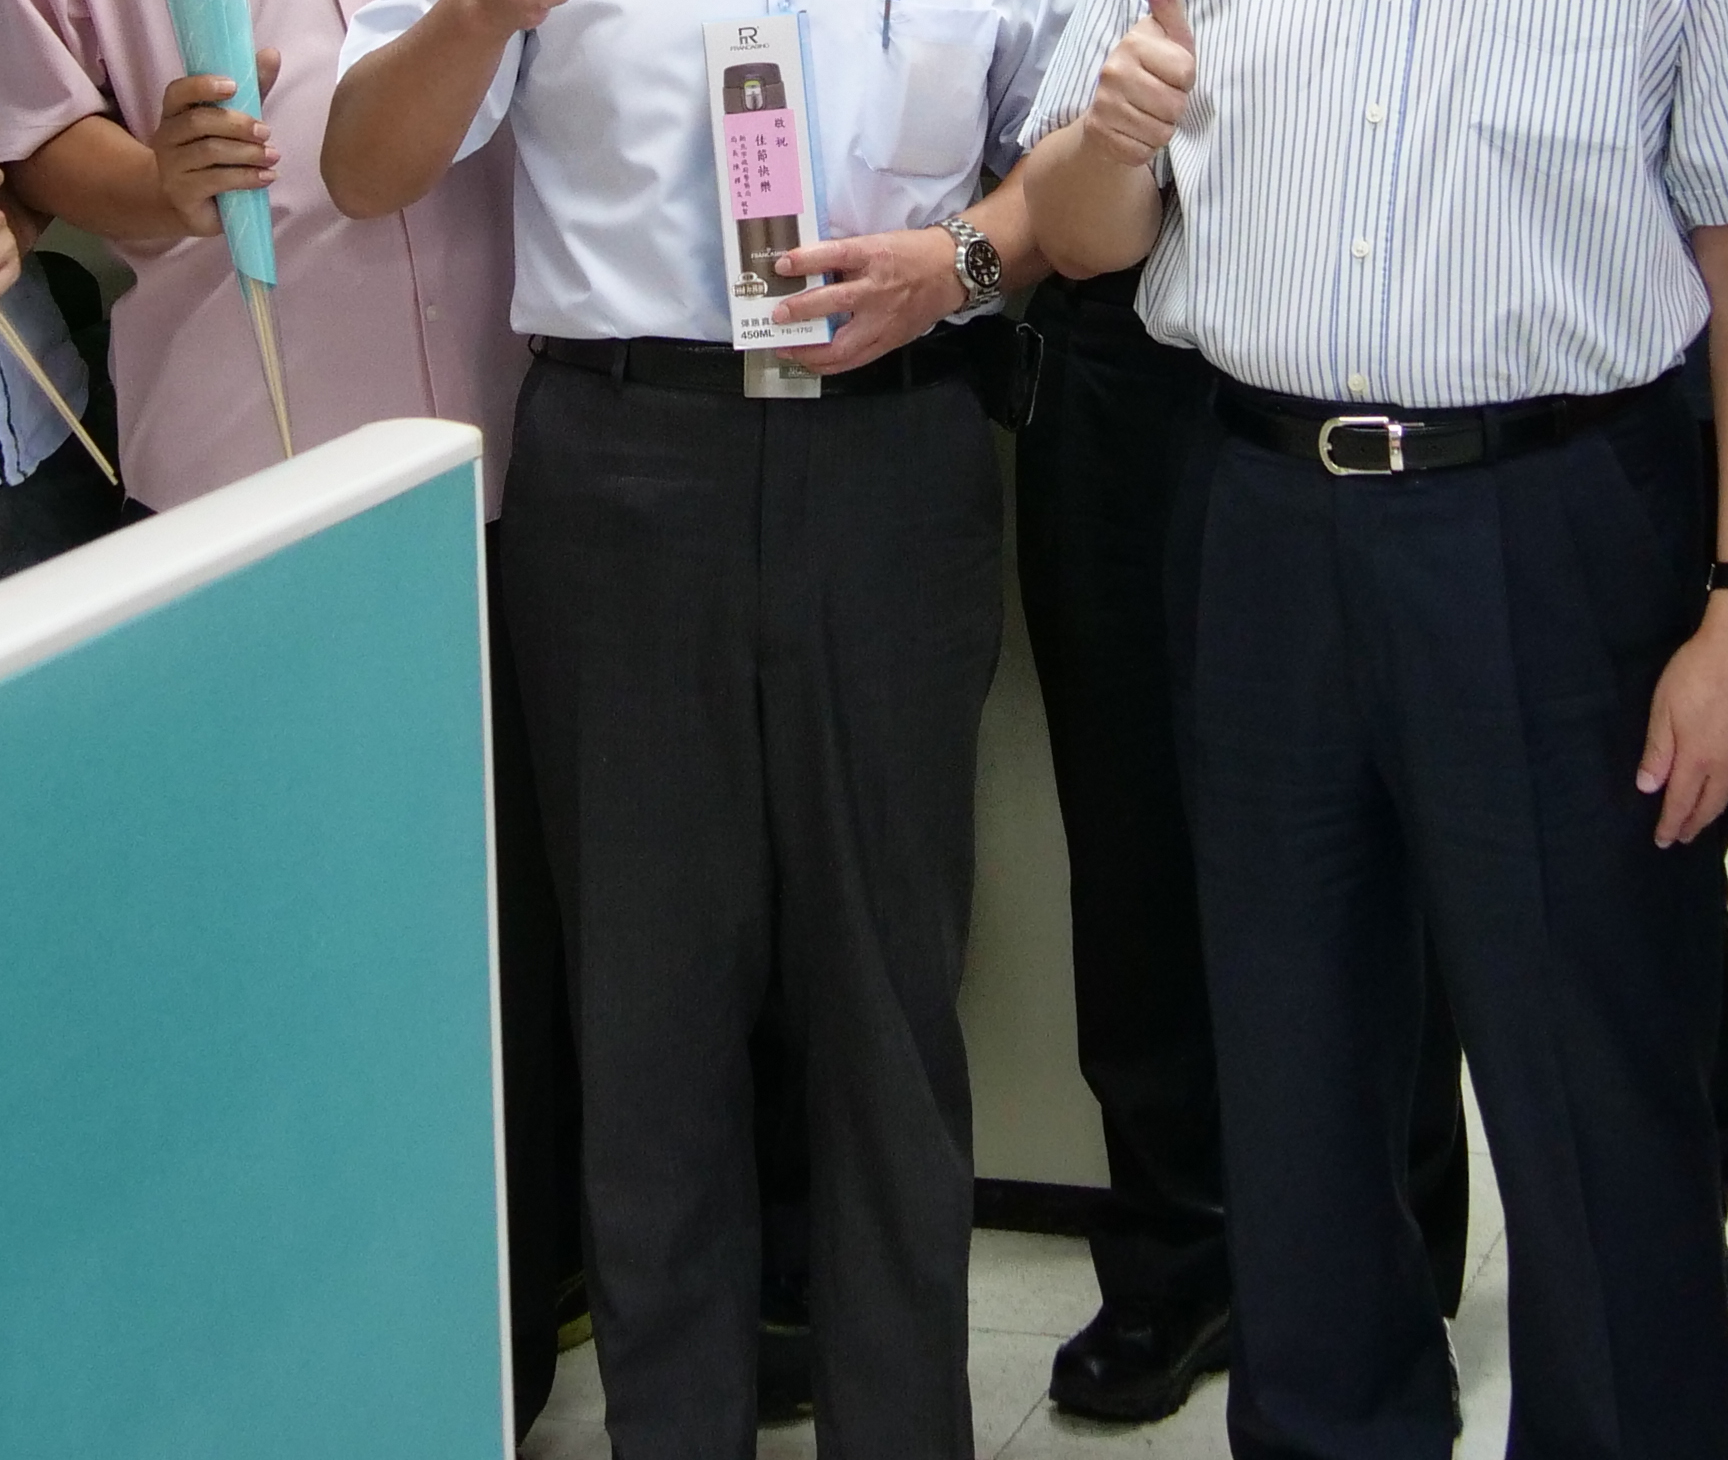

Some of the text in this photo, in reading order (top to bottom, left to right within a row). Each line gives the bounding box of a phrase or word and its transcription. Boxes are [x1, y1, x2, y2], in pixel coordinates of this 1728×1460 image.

[755, 133, 771, 193] 佳節快樂
[741, 329, 775, 340] 450ML
